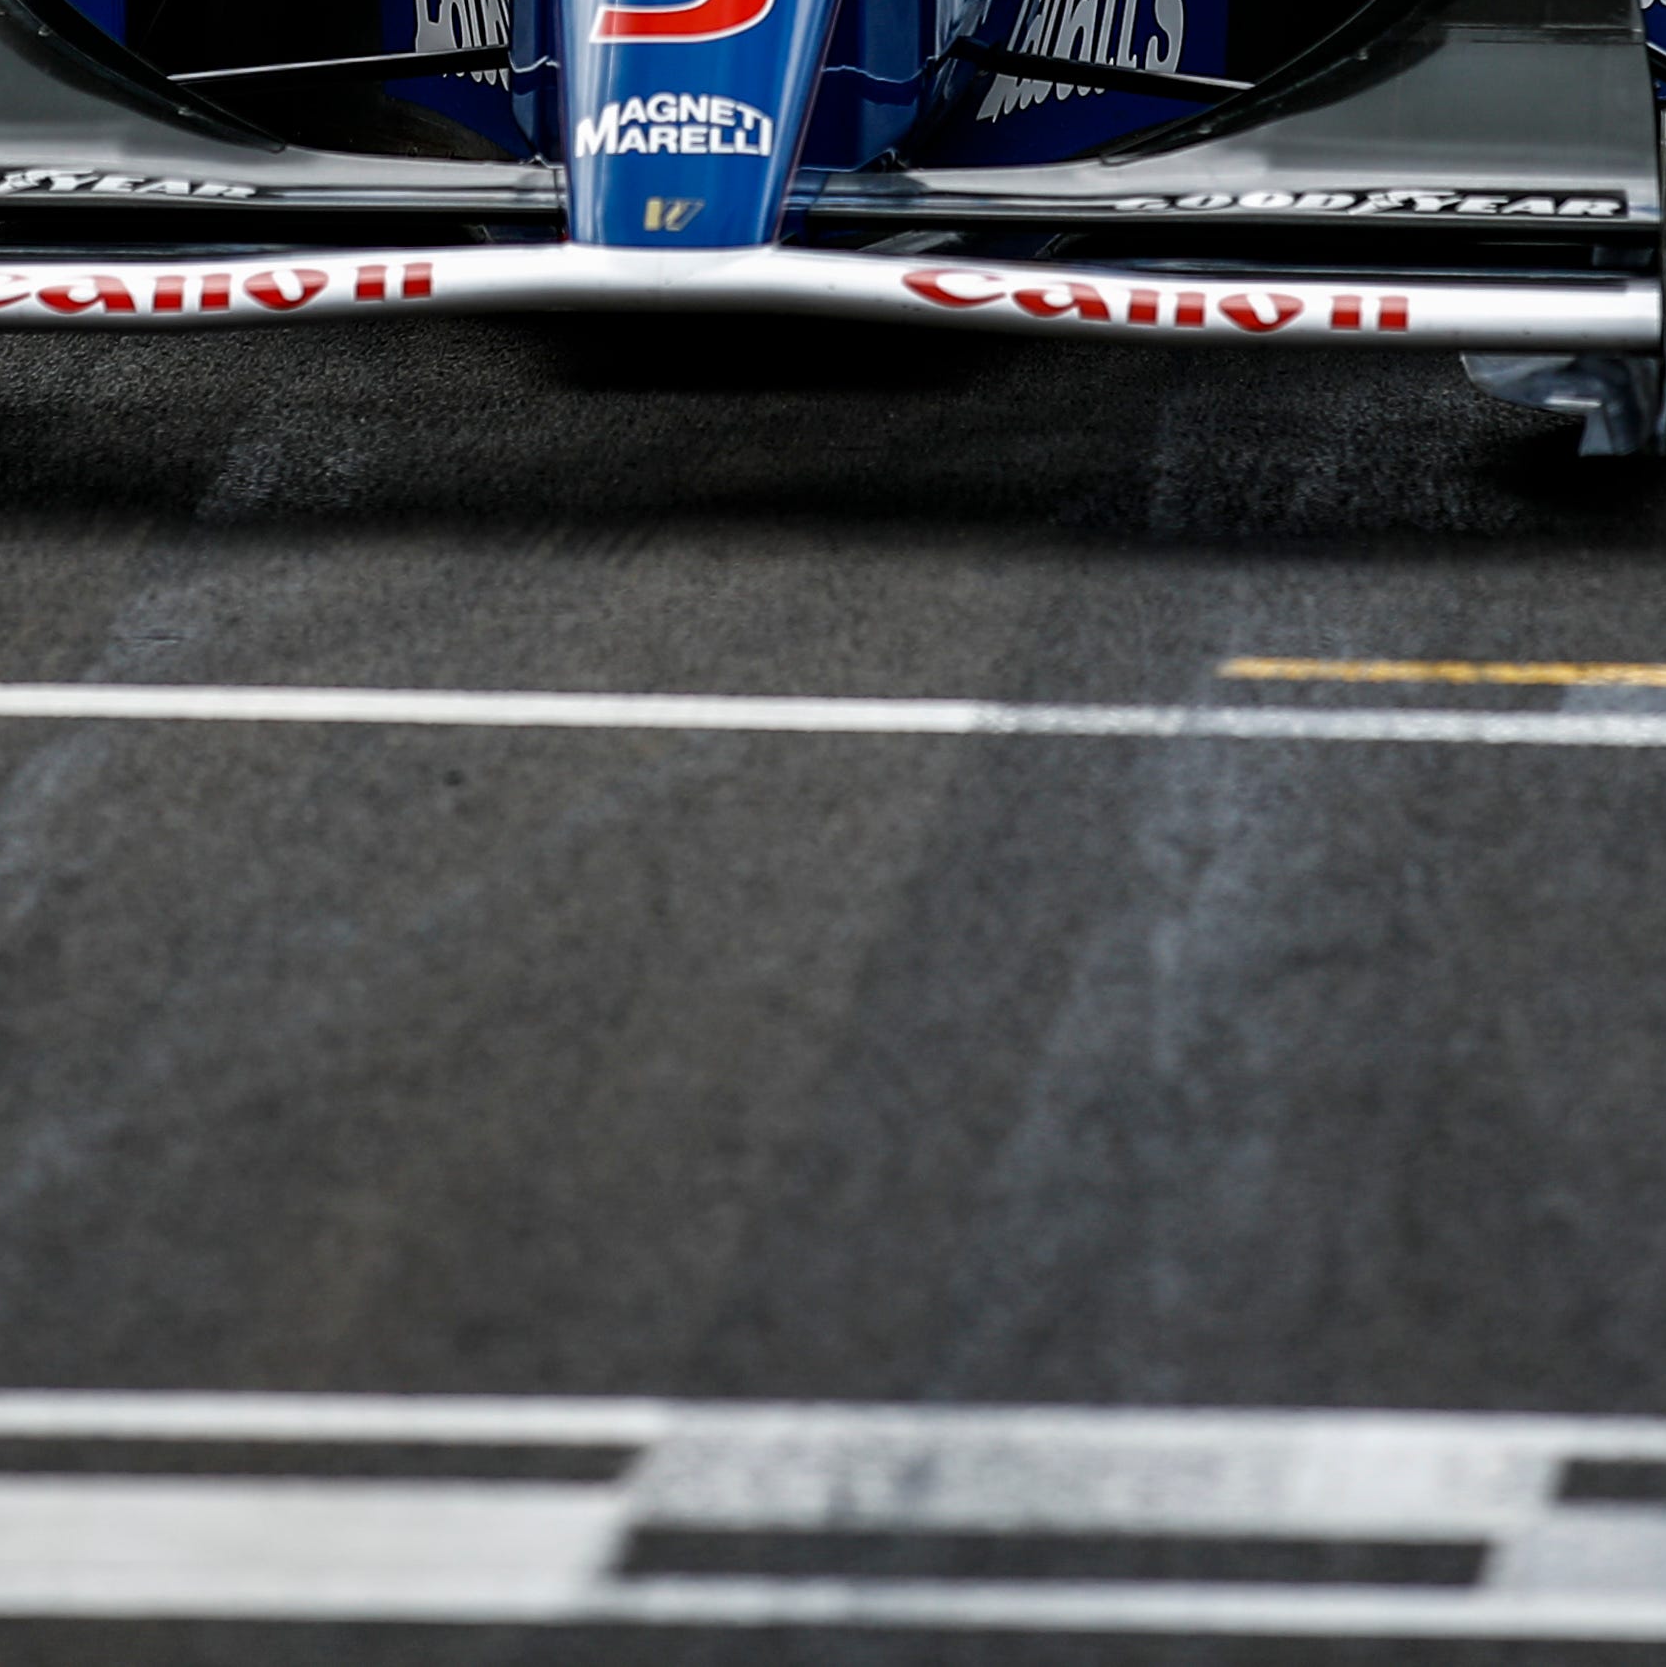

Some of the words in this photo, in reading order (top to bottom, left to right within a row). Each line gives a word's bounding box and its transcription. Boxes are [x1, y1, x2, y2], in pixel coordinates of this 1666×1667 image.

[576, 92, 773, 135] MAGNETI
[576, 117, 773, 157] MARELLI
[902, 268, 1408, 332] Canon
